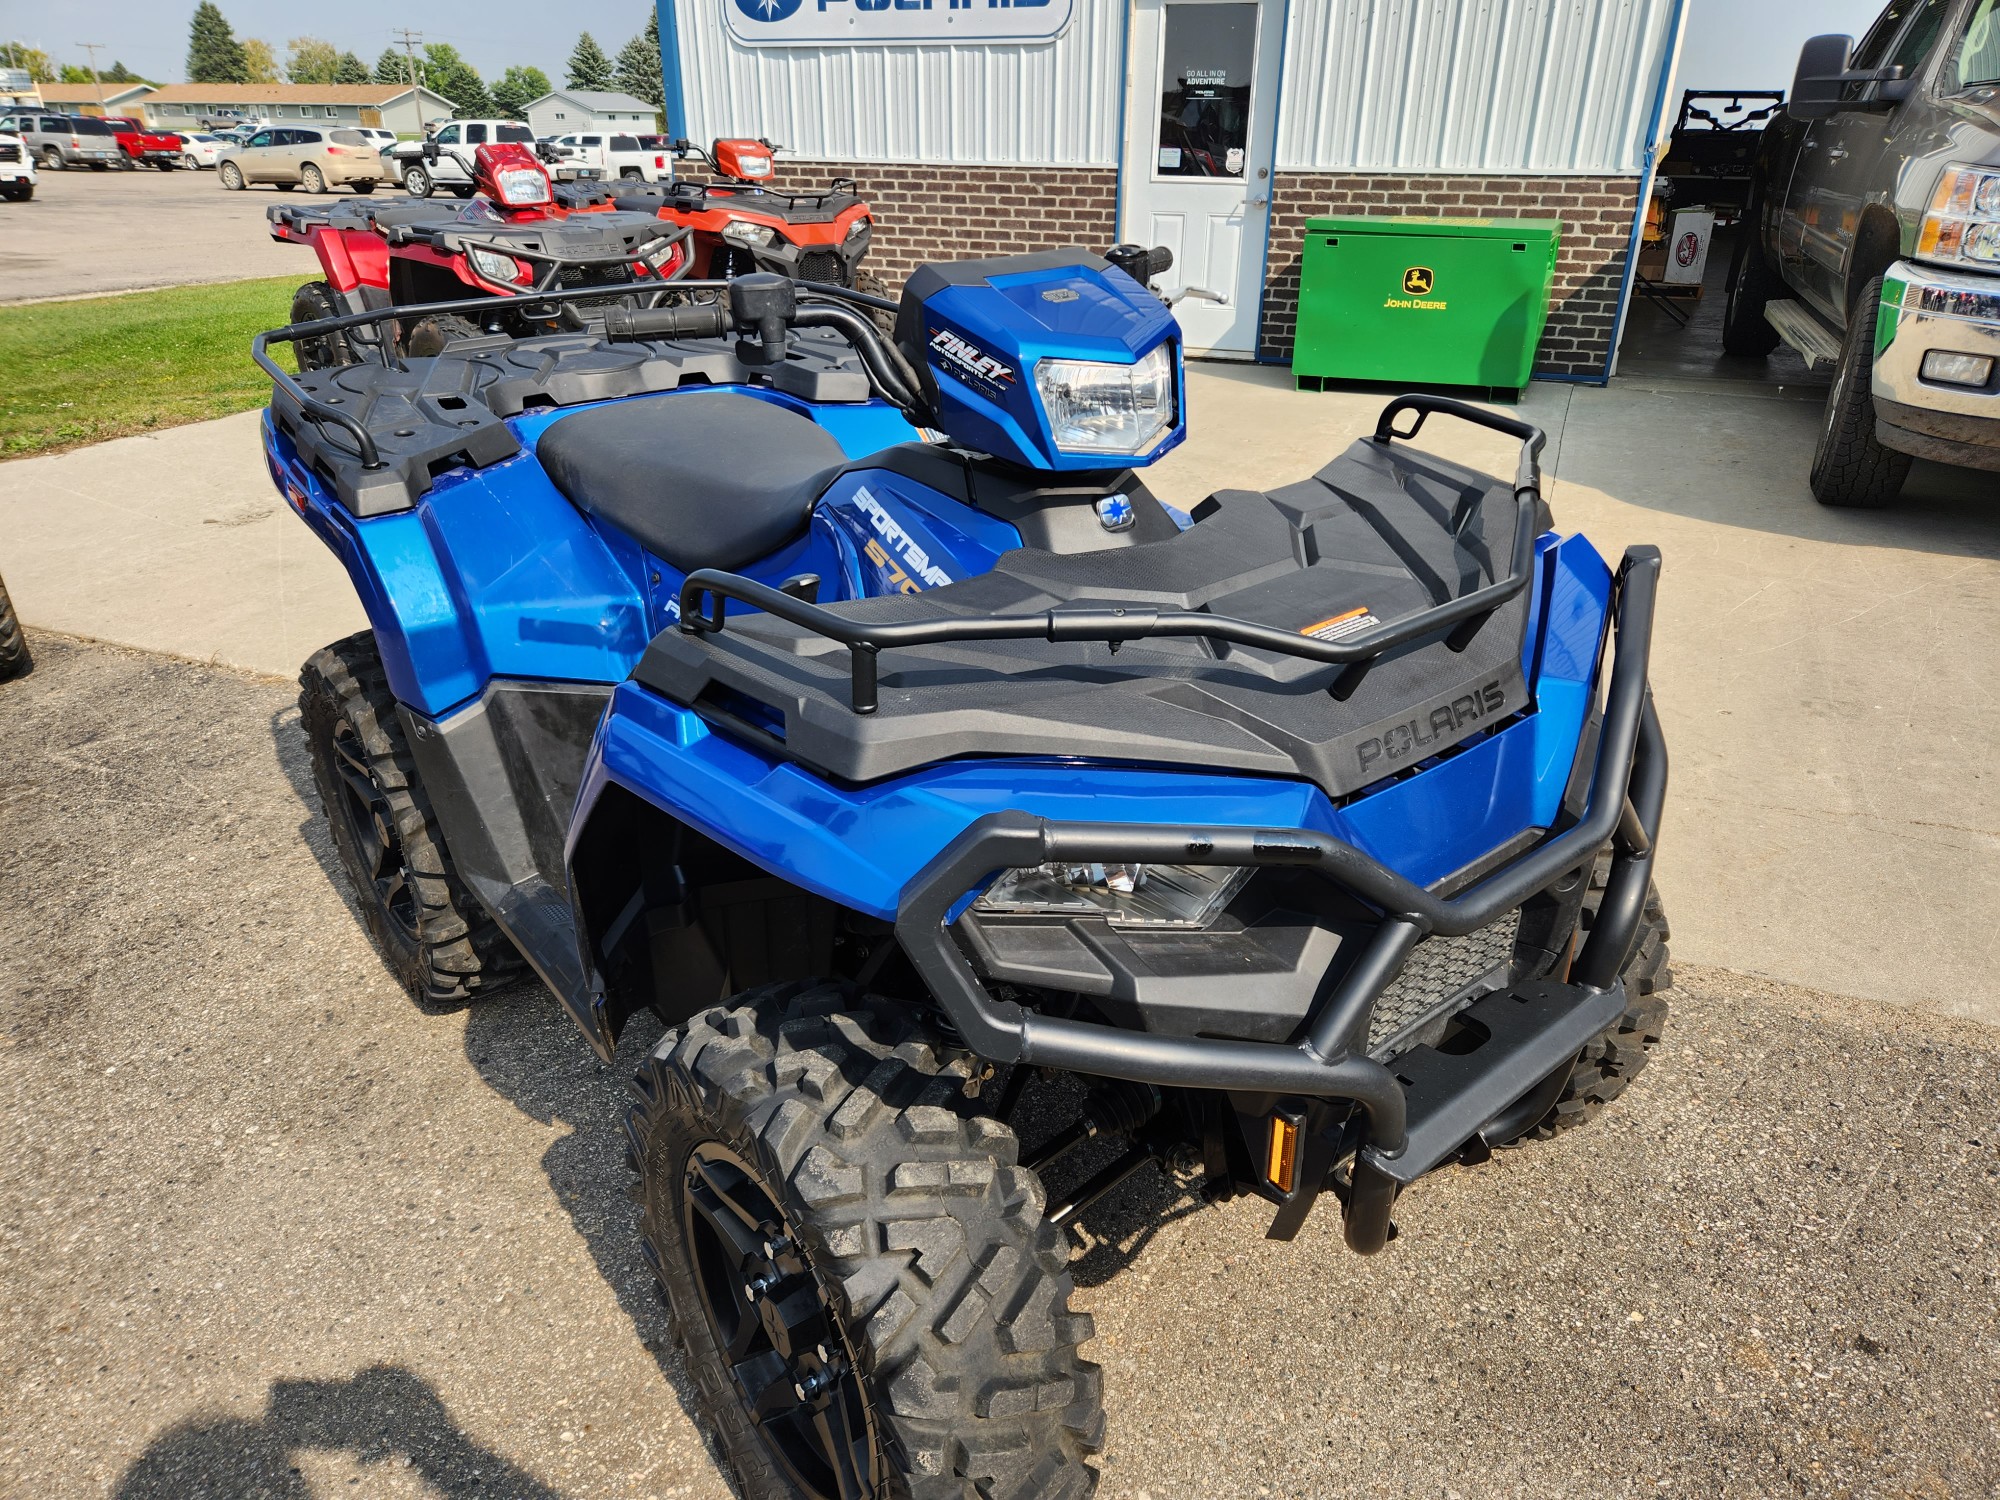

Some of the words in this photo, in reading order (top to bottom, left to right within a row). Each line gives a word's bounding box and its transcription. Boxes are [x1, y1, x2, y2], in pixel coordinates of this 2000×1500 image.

[1384, 298, 1412, 309] JOHN
[1413, 299, 1447, 310] DEERE
[929, 341, 984, 379] MOTORSPORTS
[932, 330, 1013, 379] FINLEY
[852, 485, 954, 587] SPORTSMA
[1355, 680, 1506, 773] POLARIS
